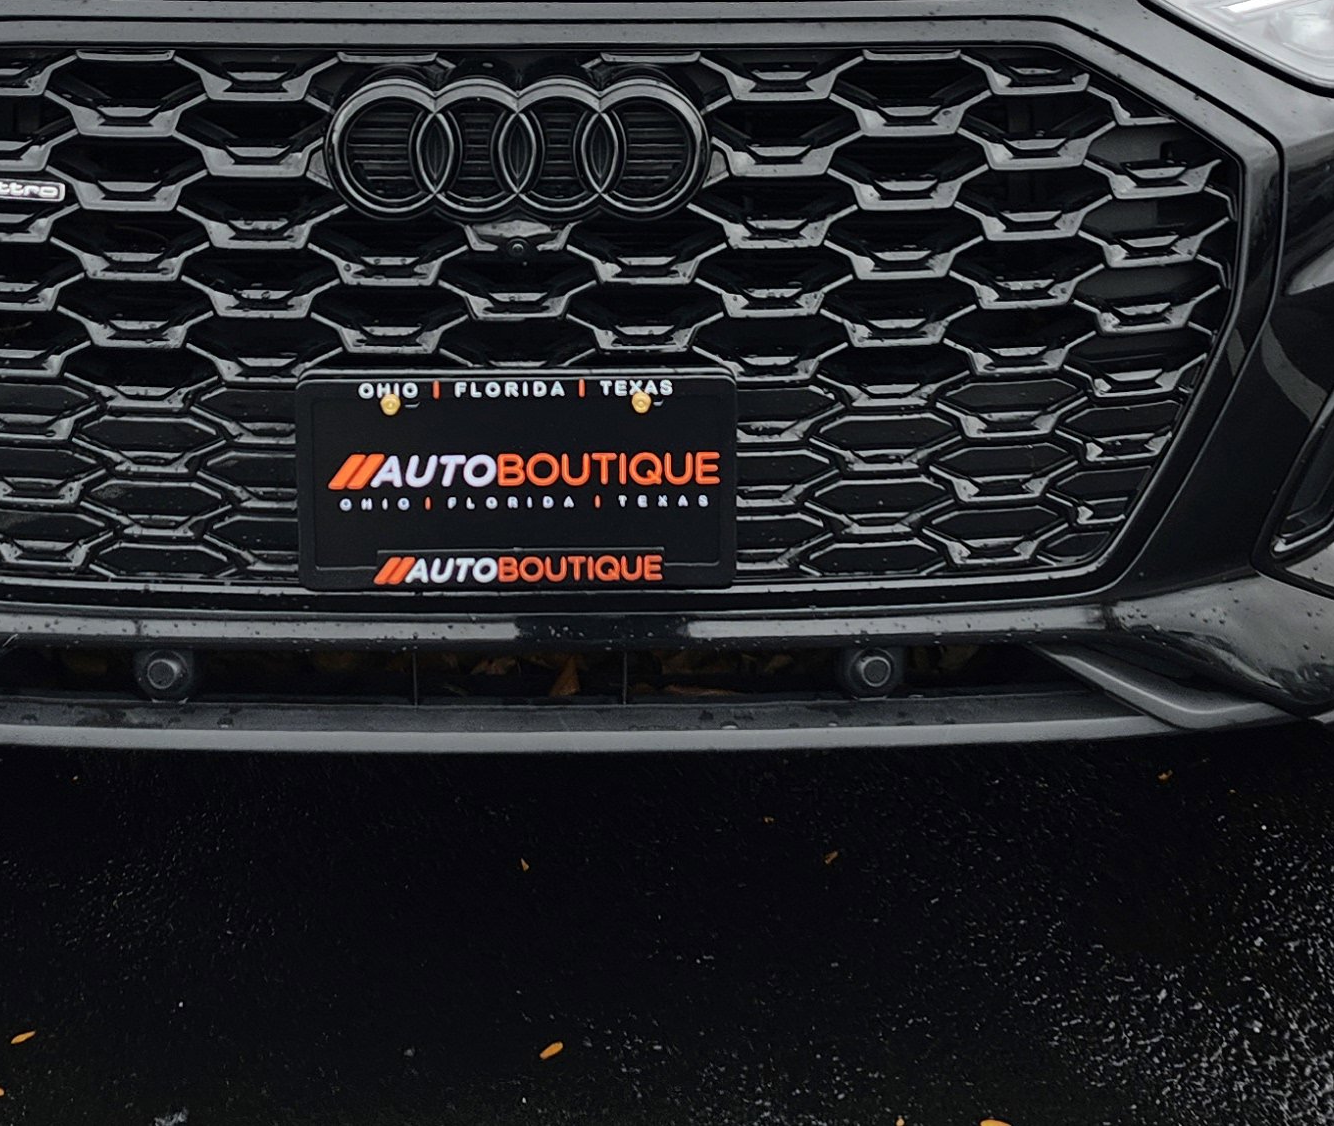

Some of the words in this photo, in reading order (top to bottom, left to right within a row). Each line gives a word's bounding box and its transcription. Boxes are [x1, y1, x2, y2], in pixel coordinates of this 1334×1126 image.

[358, 381, 419, 399] OHIO
[454, 380, 565, 399] FLORIDA
[599, 379, 673, 397] TEXAS
[370, 452, 721, 488] AUTOBOUTIQUE
[339, 496, 410, 511] OHIO
[447, 495, 575, 510] FLORIDA
[618, 494, 709, 508] TEXAS
[404, 555, 663, 584] AUTOBOUTIQUE
